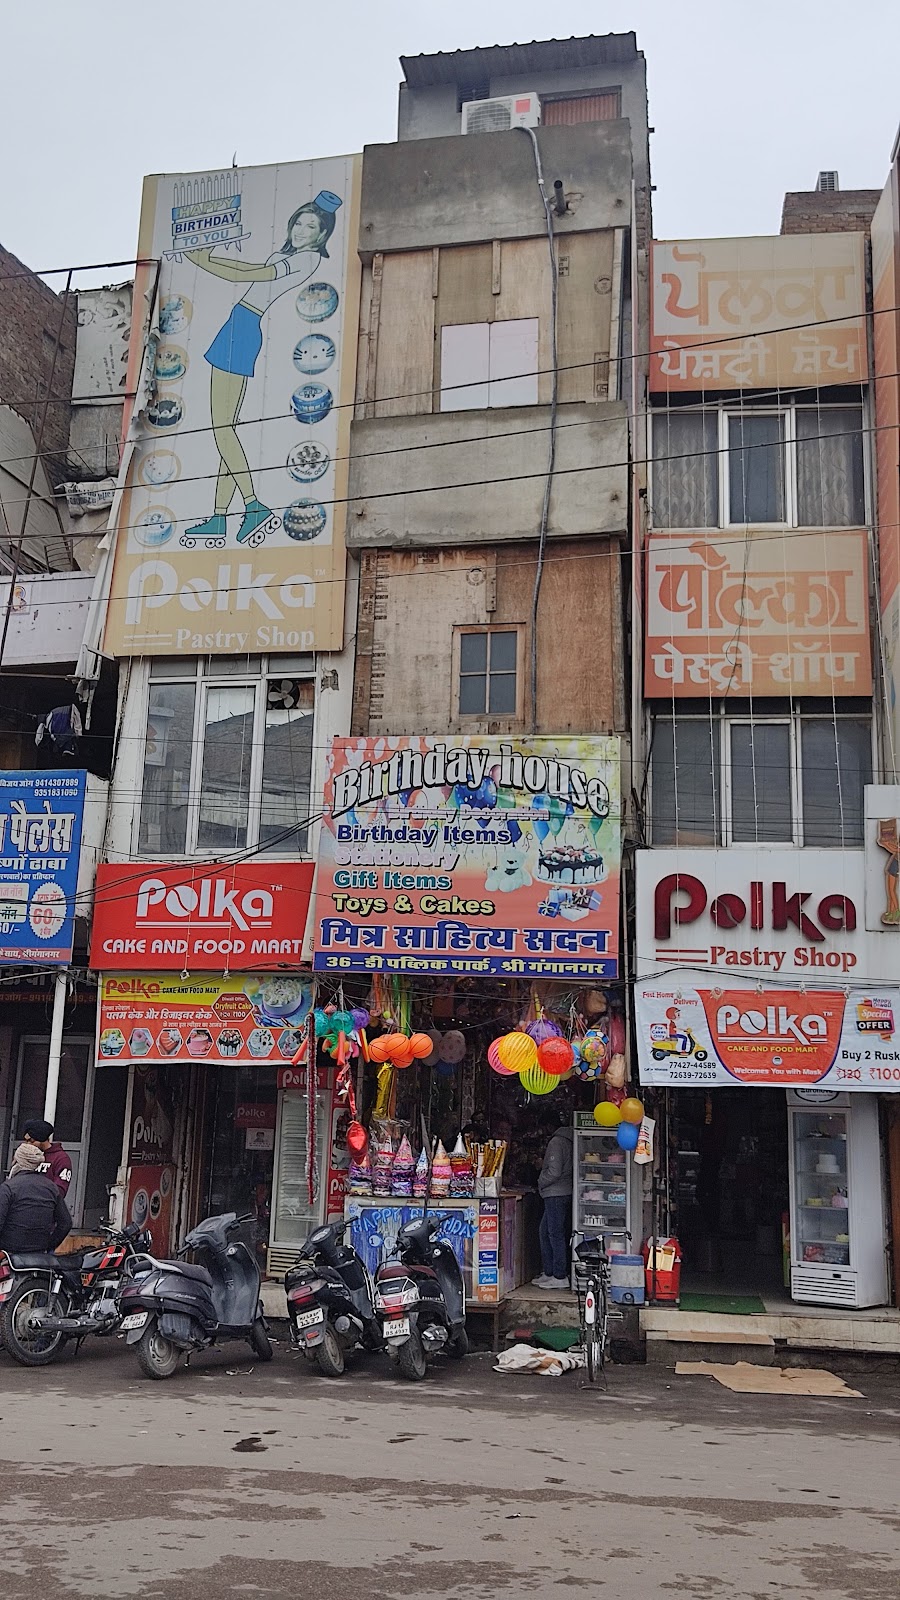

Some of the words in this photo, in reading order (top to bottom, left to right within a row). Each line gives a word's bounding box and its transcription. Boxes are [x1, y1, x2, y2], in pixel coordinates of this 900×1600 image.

[178, 199, 235, 219] HAPPY
[174, 212, 238, 234] BIRTHDAY
[182, 236, 199, 247] TO
[203, 230, 230, 243] YOU
[125, 559, 318, 625] Polka
[175, 628, 249, 651] Pastry
[256, 625, 316, 648] Shop
[769, 641, 861, 683] शॉप
[332, 743, 489, 818] Birthday
[498, 744, 610, 818] house
[10, 799, 76, 853] पैलेस
[337, 825, 439, 847] Birthday
[443, 826, 513, 844] Items
[29, 858, 68, 870] ढाबा
[334, 847, 460, 871] Stationery
[334, 870, 379, 889] Gift
[383, 871, 453, 890] Items
[136, 879, 274, 931] Polka
[332, 894, 388, 915] Toys
[394, 895, 413, 913] &
[420, 895, 496, 915] Cakes
[654, 873, 857, 941] Polka
[320, 919, 388, 950] मित्र
[393, 921, 517, 952] साहित्य
[523, 928, 612, 953] सदन
[103, 940, 146, 954] CAKE
[151, 940, 189, 954] AND
[194, 940, 246, 954] FOOD
[251, 940, 303, 954] MART
[501, 961, 526, 973] श्री
[528, 957, 606, 975] गंगानगर
[710, 946, 786, 970] Pastry
[793, 947, 857, 972] Shop
[105, 979, 161, 998] Polka
[215, 1003, 236, 1011] Dryfruit
[673, 998, 699, 1006] Delivery
[127, 1008, 144, 1019] केक
[144, 1008, 158, 1019] और
[195, 1008, 213, 1019] केक
[861, 1009, 890, 1019] Special
[716, 1005, 828, 1045] Polka
[842, 1051, 861, 1061] Buy
[865, 1051, 871, 1060] 2
[874, 1051, 900, 1060] Rusk
[670, 1071, 717, 1079] 72639-72639
[481, 1202, 497, 1212] Toys
[481, 1218, 497, 1230] Gifts
